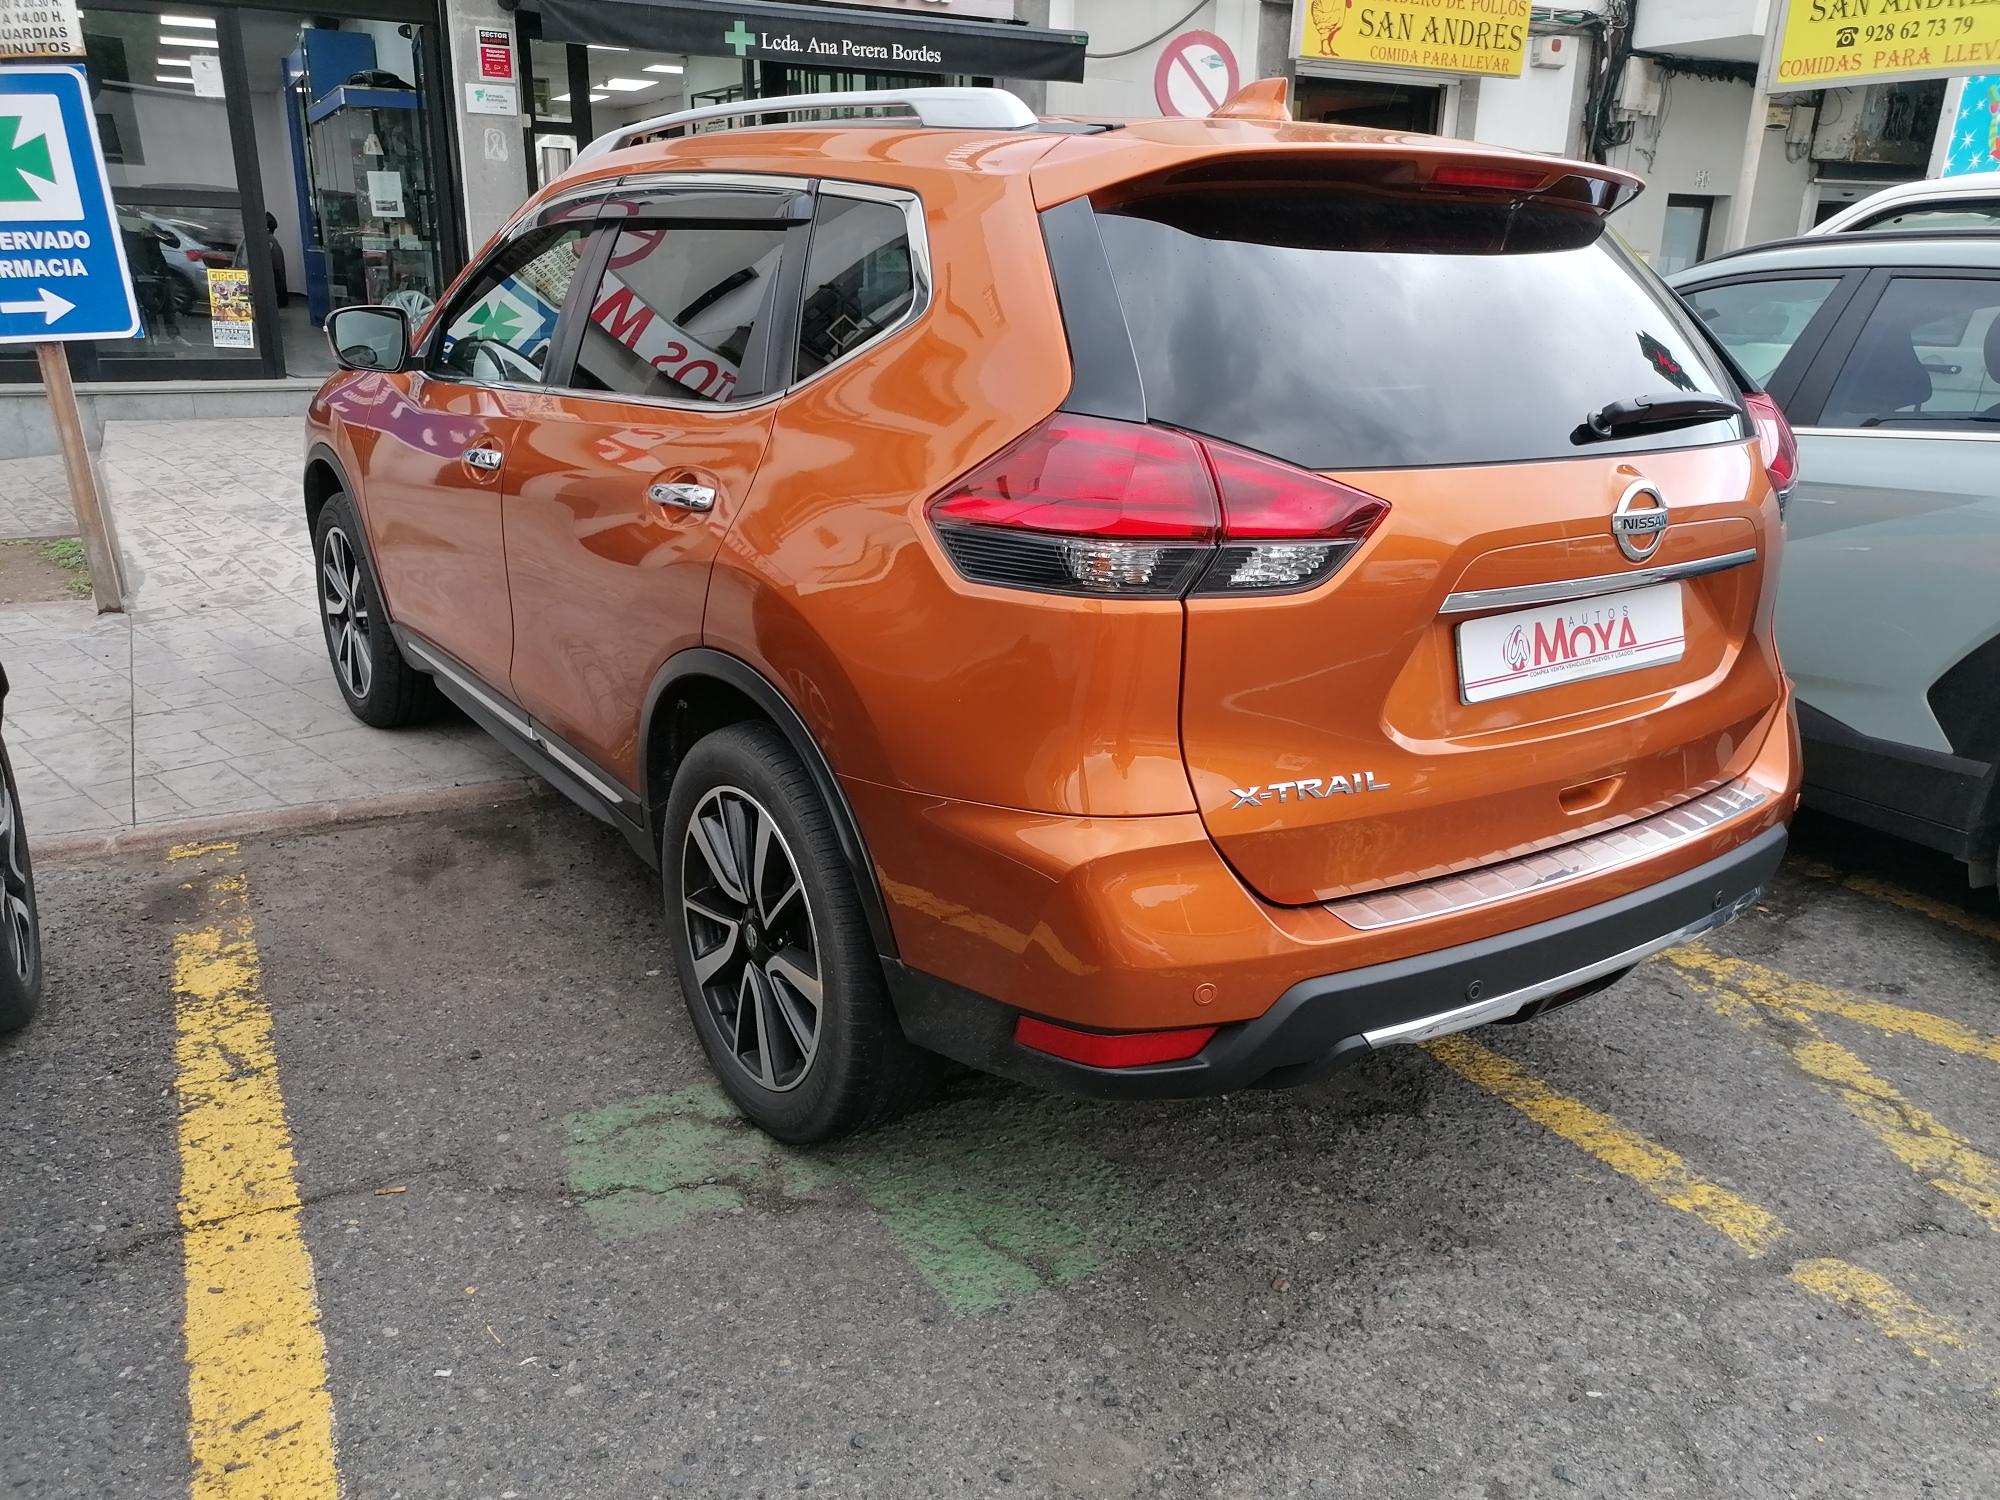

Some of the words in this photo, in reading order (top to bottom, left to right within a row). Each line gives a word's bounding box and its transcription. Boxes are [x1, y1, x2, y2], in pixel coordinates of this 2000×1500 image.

[3, 13, 12, 25] A
[14, 11, 48, 24] 14.00
[1471, 0, 1527, 17] POLLOS
[0, 26, 68, 40] UARDIAS
[481, 31, 508, 39] SECTOR
[1359, 8, 1415, 41] SAN
[1421, 15, 1524, 52] ANDRÉS
[1864, 24, 1896, 43] 928
[1900, 21, 1921, 40] 62
[1927, 18, 1947, 38] 73
[1954, 16, 1975, 36] 79
[760, 32, 803, 53] Lcda.
[806, 36, 838, 55] Ana
[841, 39, 888, 59] Perera
[892, 43, 942, 63] Bordes
[1370, 45, 1418, 64] COMIDA
[1423, 49, 1458, 67] PARA
[1462, 53, 1510, 72] LLEVAR
[1779, 53, 1863, 78] COMIDAS
[1873, 47, 1932, 69] PARA
[210, 271, 248, 281] CIRCUS
[1623, 515, 1667, 530] NISSAN
[1568, 605, 1629, 628] AUTOS
[1534, 616, 1637, 667] MOYA
[1529, 668, 1550, 678] COMPRA
[1550, 664, 1566, 674] VENTA
[1230, 771, 1391, 809] X-TRAIL
